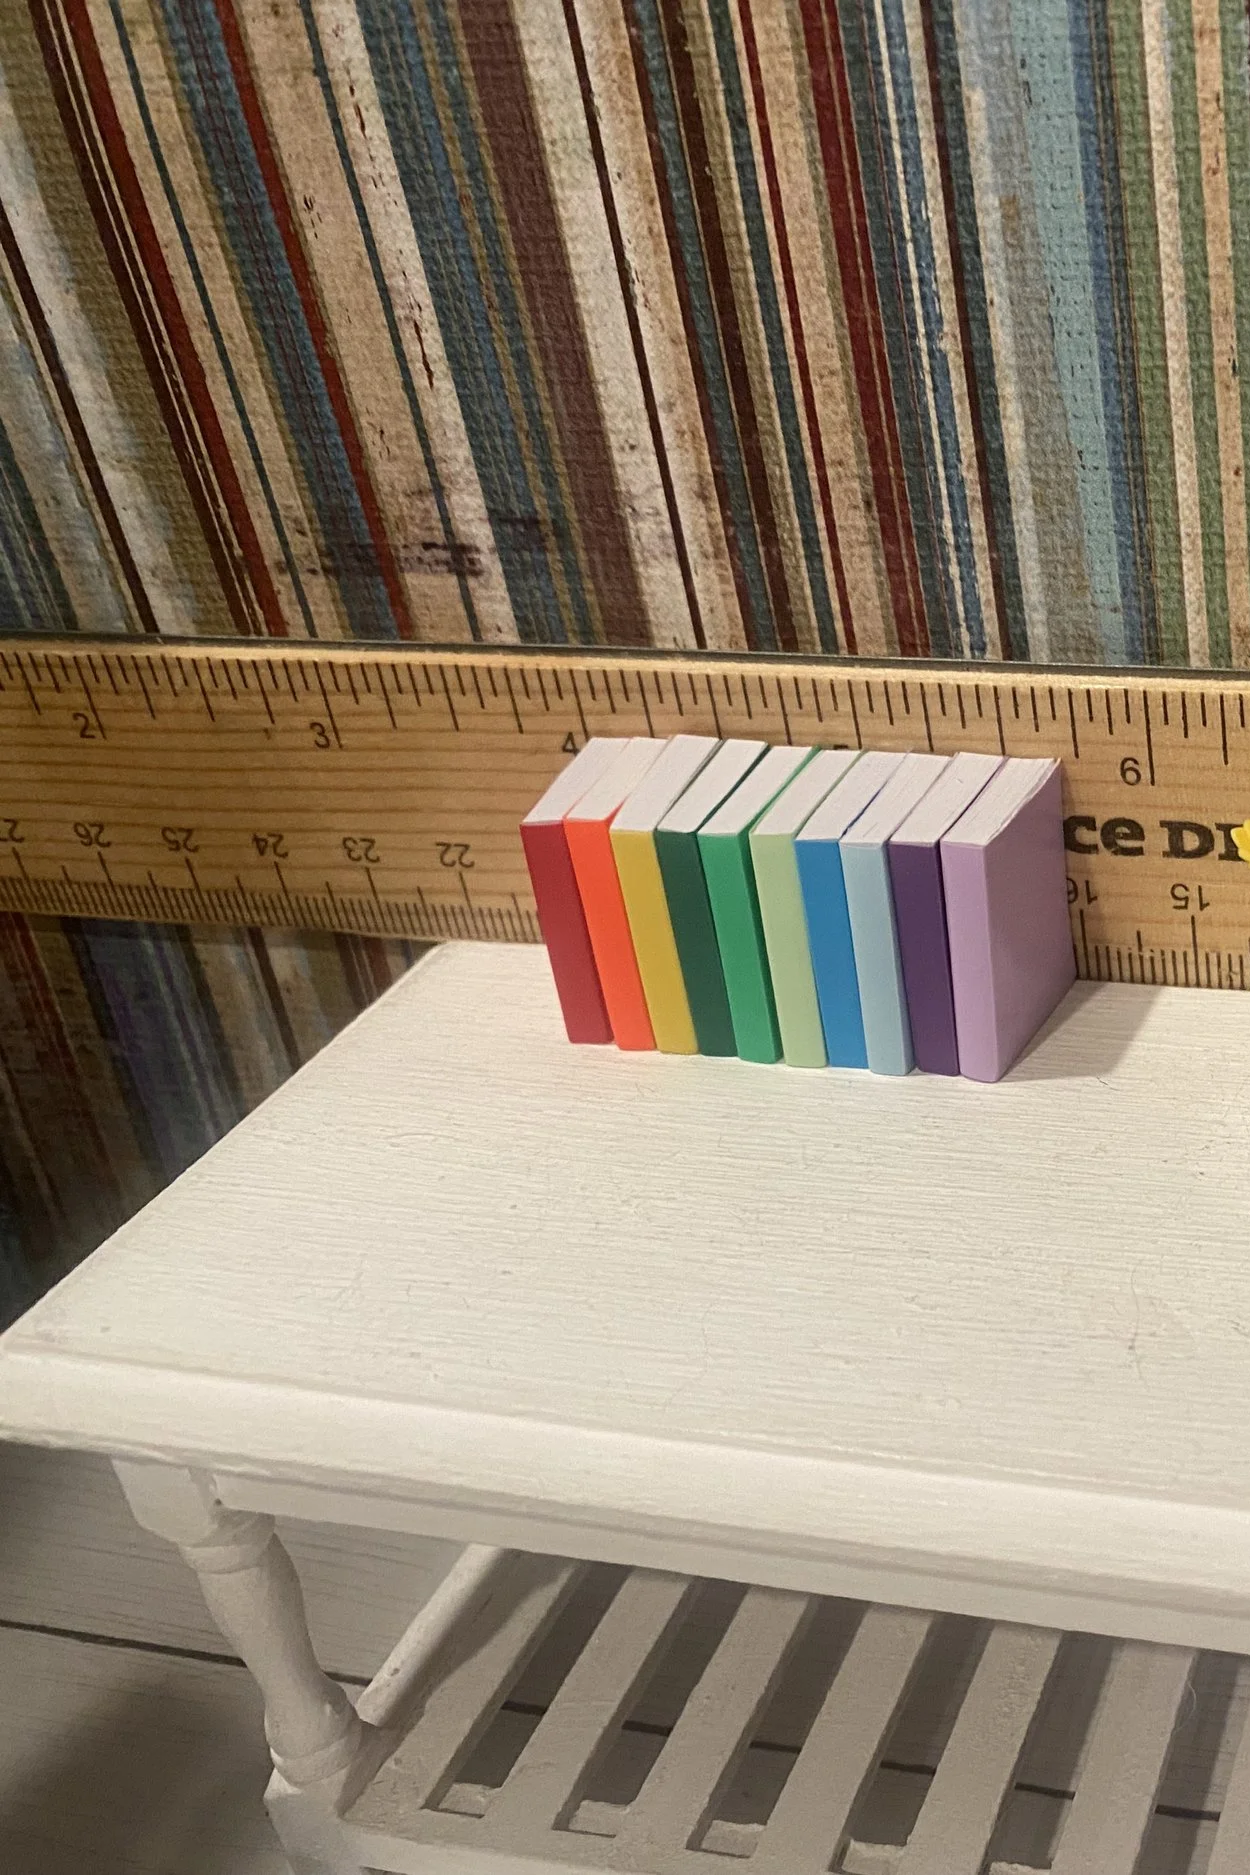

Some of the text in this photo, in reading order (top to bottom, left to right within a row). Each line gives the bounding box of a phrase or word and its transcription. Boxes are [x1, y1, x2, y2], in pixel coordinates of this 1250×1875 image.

[73, 713, 97, 738] 2
[310, 723, 331, 749] 3
[562, 731, 580, 757] 4
[1120, 757, 1142, 785] 6
[161, 827, 198, 853] 25
[252, 833, 288, 857] 24
[341, 837, 380, 863] 23
[435, 842, 475, 868] 22
[1170, 883, 1210, 911] 15
